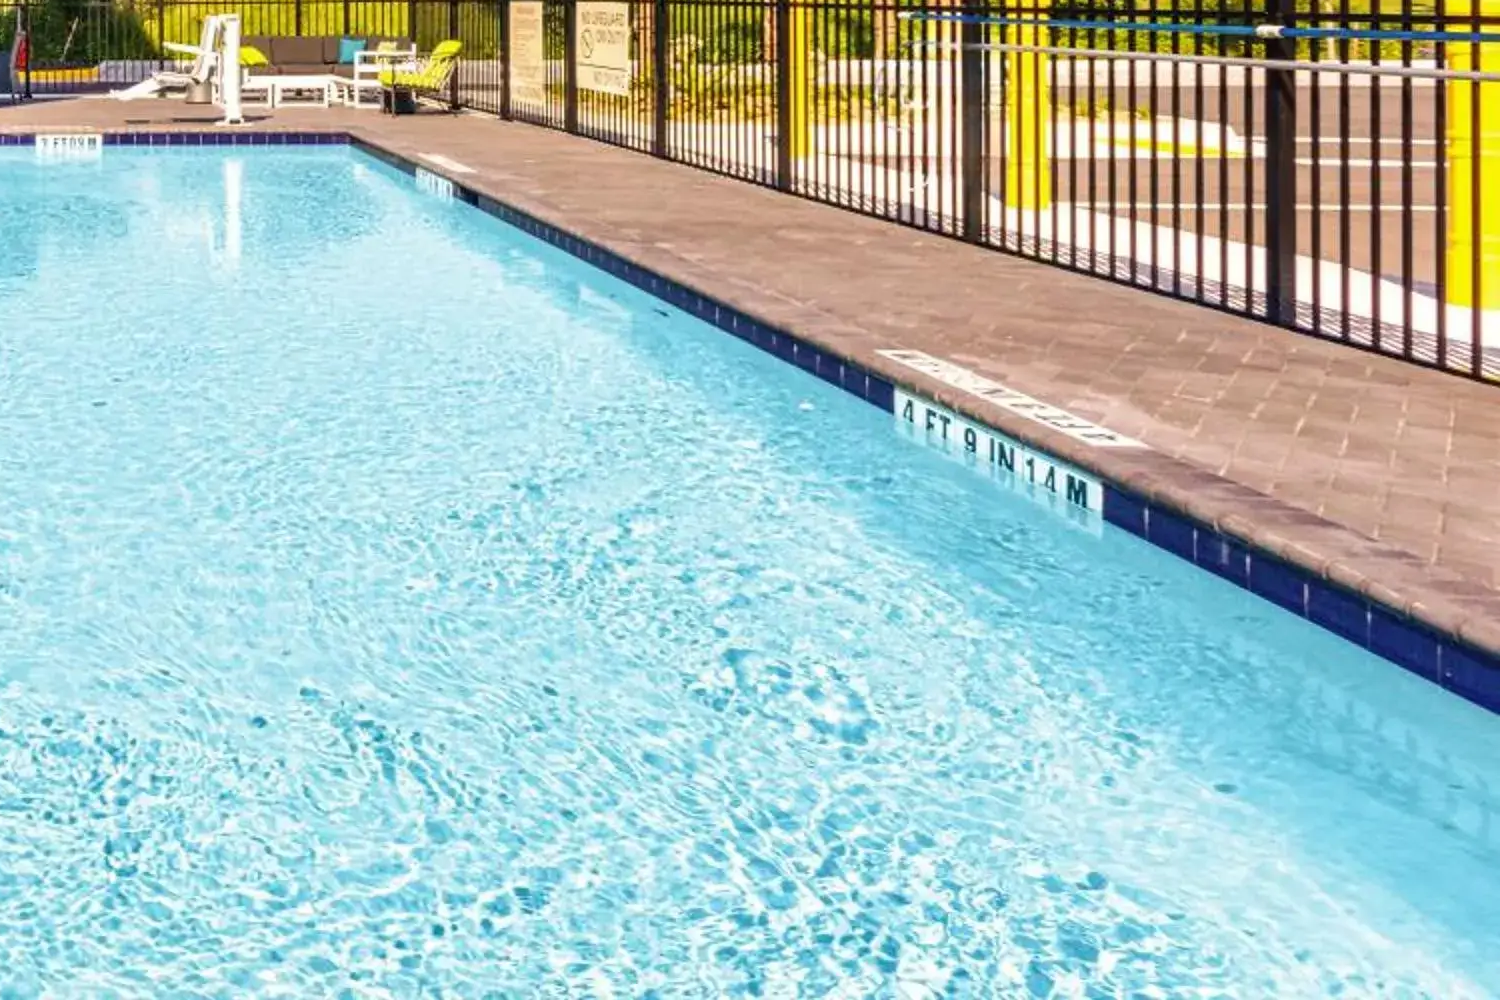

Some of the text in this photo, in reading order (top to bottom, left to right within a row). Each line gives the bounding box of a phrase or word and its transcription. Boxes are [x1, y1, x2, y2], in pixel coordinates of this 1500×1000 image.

[903, 399, 914, 423] 4
[926, 408, 951, 440] FT
[963, 427, 977, 452] 9
[988, 437, 1014, 472] IN
[1066, 473, 1087, 508] M
